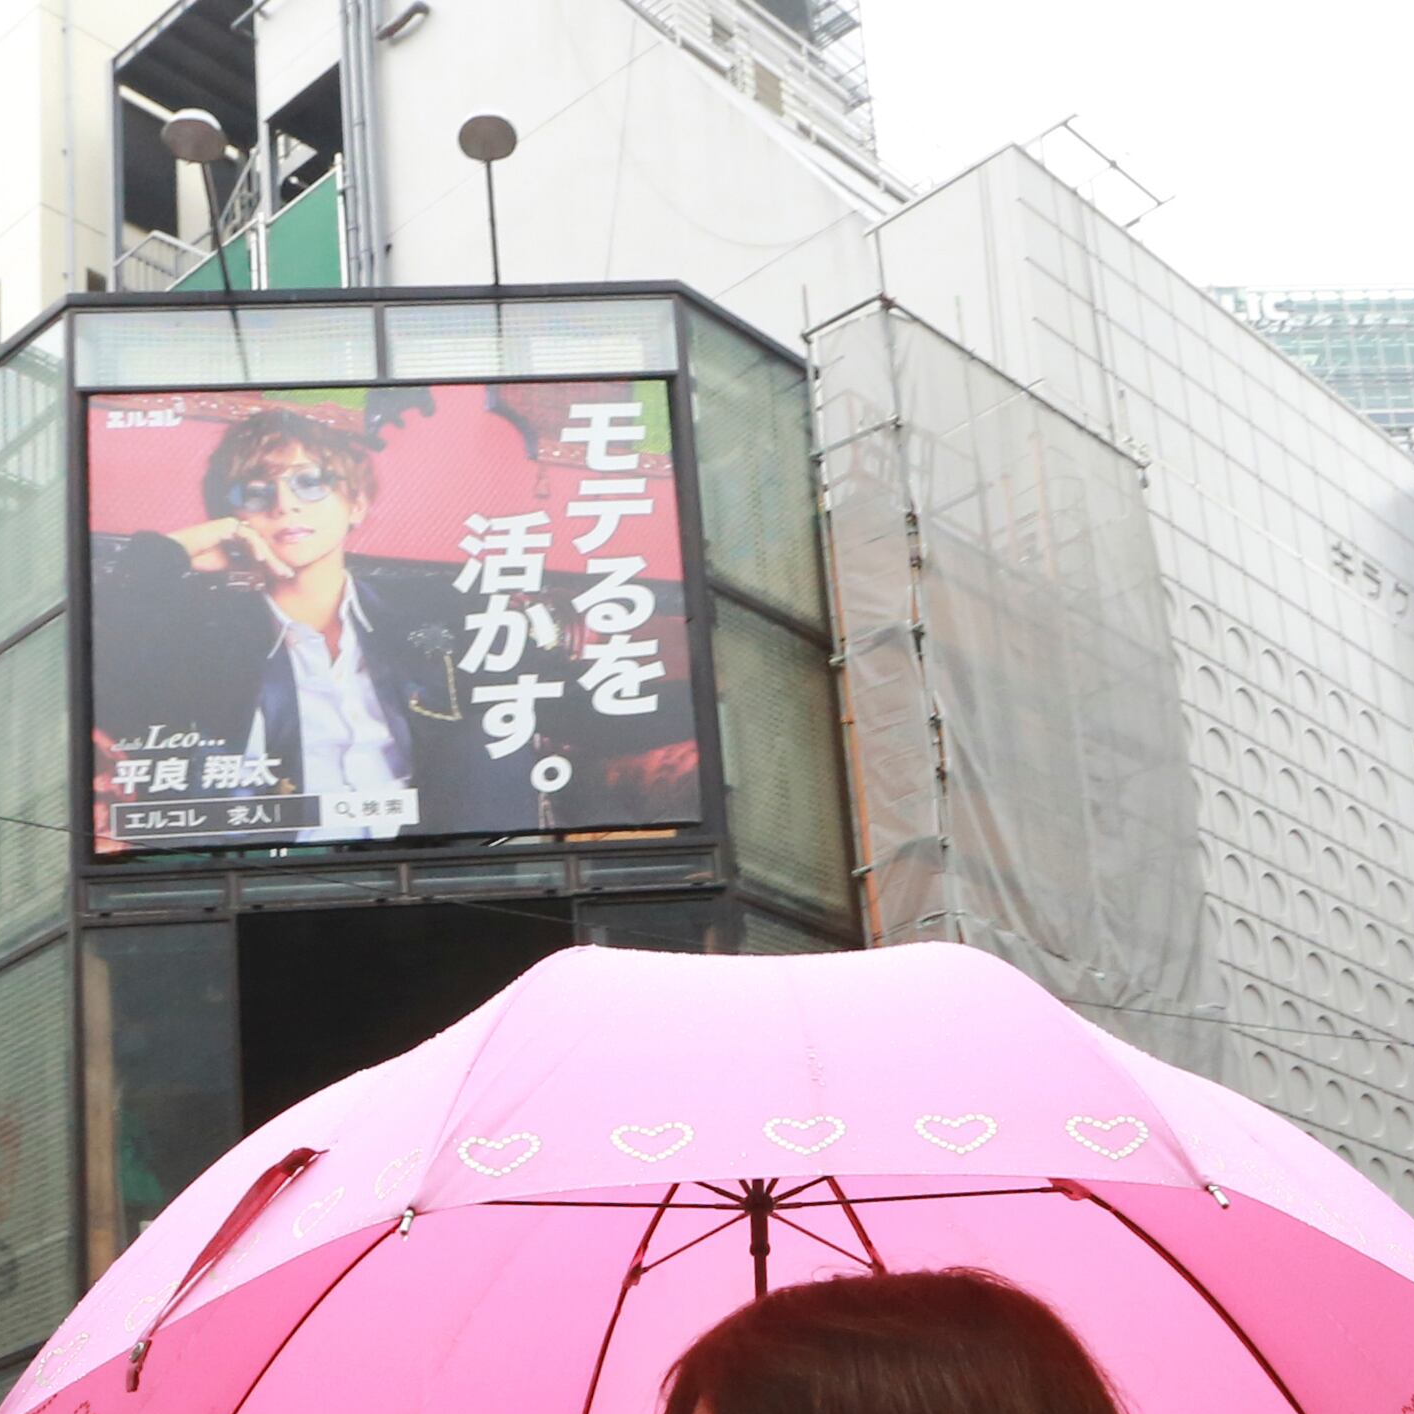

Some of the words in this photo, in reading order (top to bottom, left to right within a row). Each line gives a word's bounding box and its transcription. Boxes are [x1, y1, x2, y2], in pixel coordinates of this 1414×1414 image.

[560, 401, 666, 717] モテるを
[452, 510, 572, 794] 活かす。
[111, 757, 191, 795] 平良
[201, 752, 283, 790] 翔太
[124, 811, 208, 830] エルコレ
